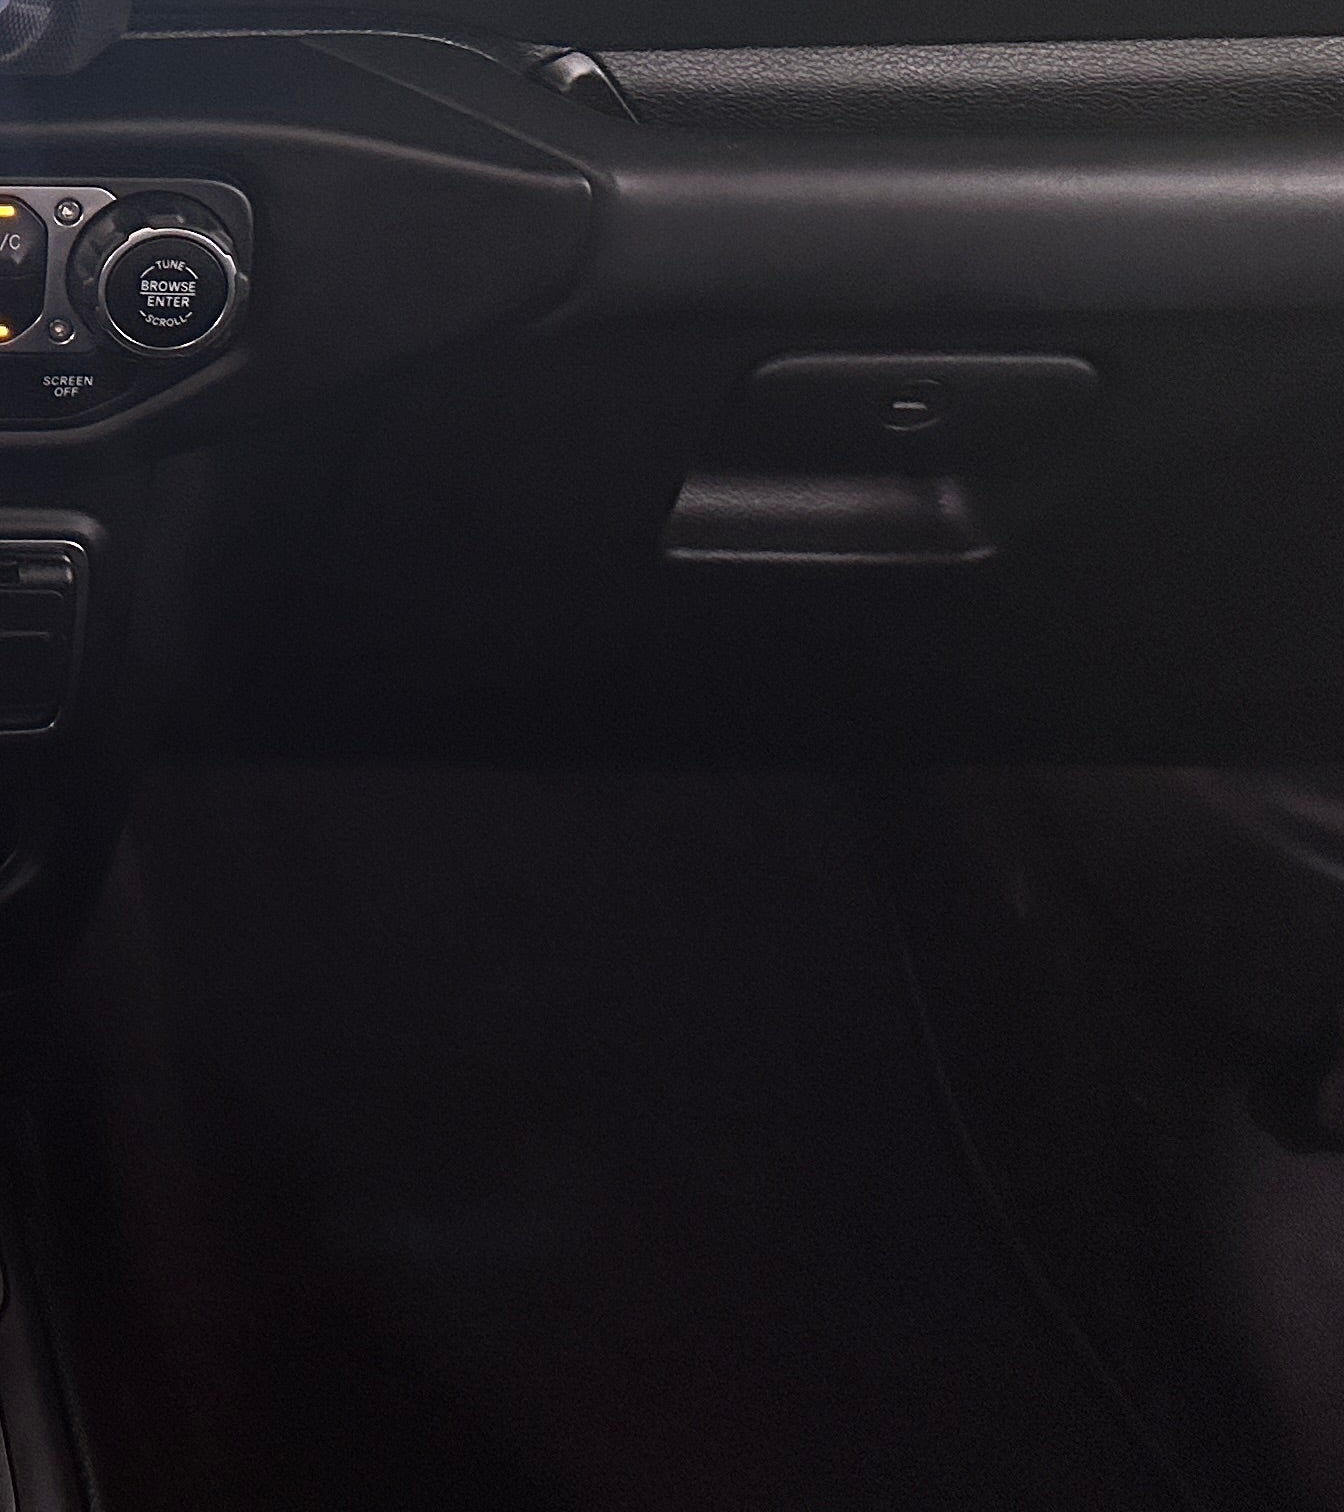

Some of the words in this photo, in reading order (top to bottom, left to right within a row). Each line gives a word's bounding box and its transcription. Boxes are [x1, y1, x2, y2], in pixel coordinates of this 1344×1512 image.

[155, 259, 187, 272] TUNE
[140, 280, 196, 293] BROWSE
[147, 295, 191, 308] ENTER
[144, 313, 188, 328] SCROLL
[43, 375, 94, 387] SCREEN
[53, 387, 79, 398] OFF
